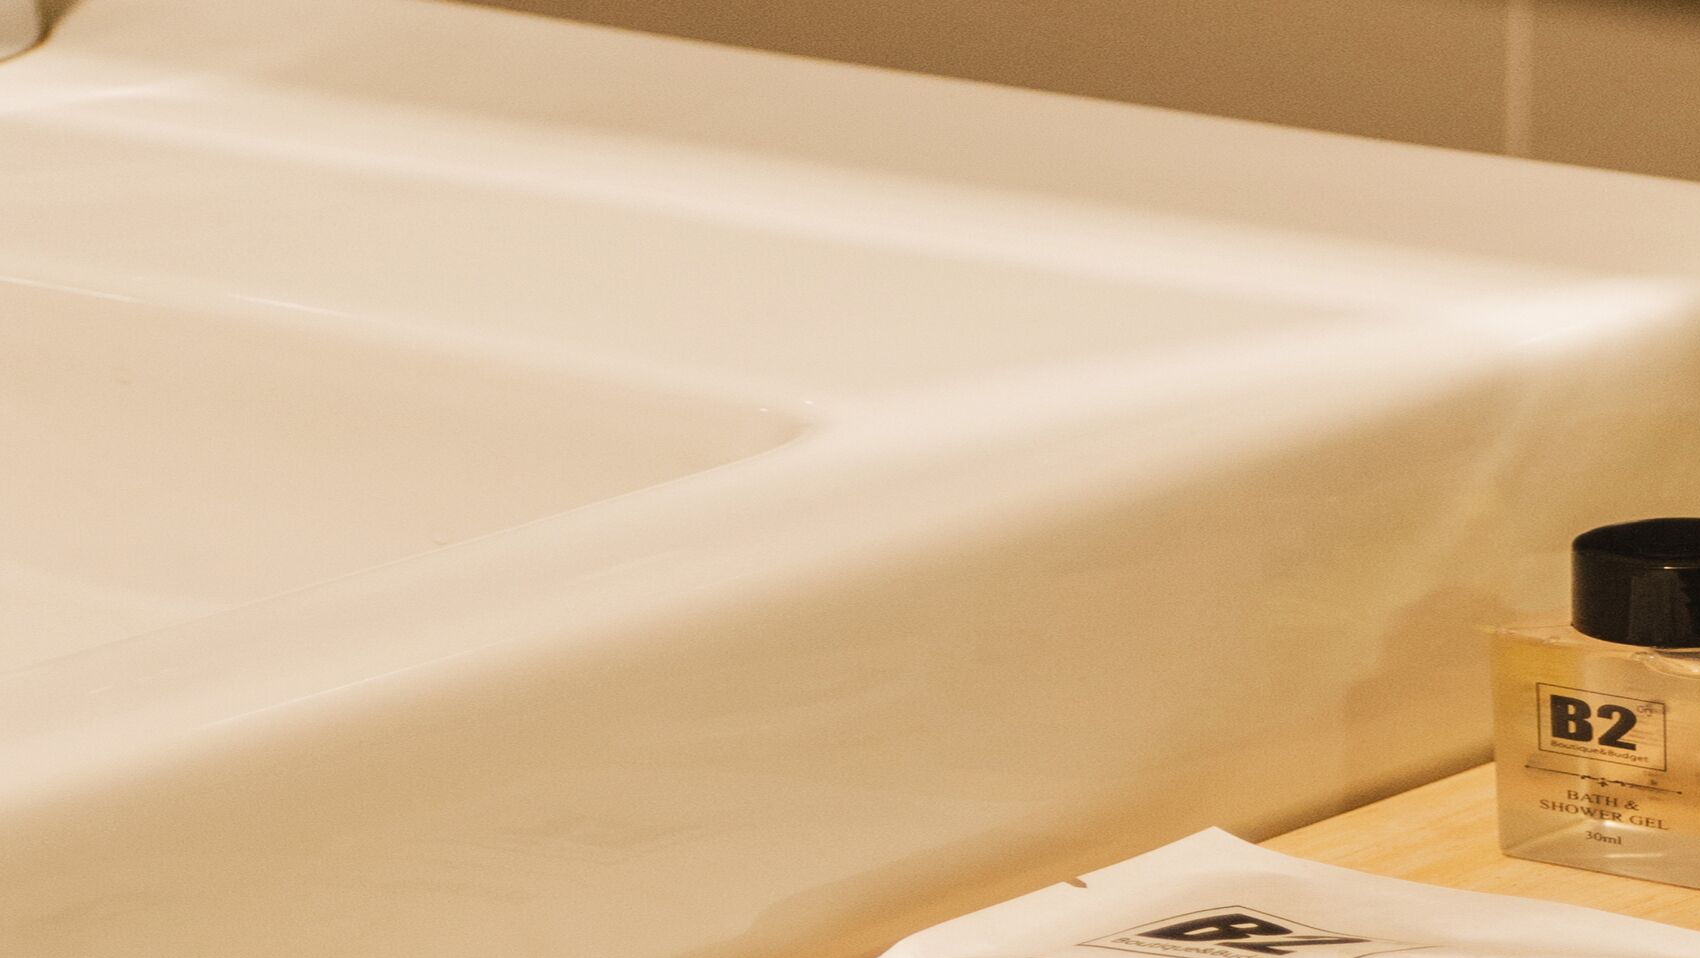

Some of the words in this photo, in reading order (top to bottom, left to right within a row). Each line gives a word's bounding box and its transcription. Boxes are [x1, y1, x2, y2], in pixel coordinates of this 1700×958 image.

[1550, 694, 1638, 751] B2
[1550, 739, 1649, 763] Boutique&Budget
[1567, 789, 1618, 807] BATH
[1624, 800, 1641, 812] &
[1539, 799, 1622, 822] SHOWER
[1629, 815, 1669, 831] GEL
[1585, 830, 1622, 845] 30ml
[1135, 913, 1374, 956] B2
